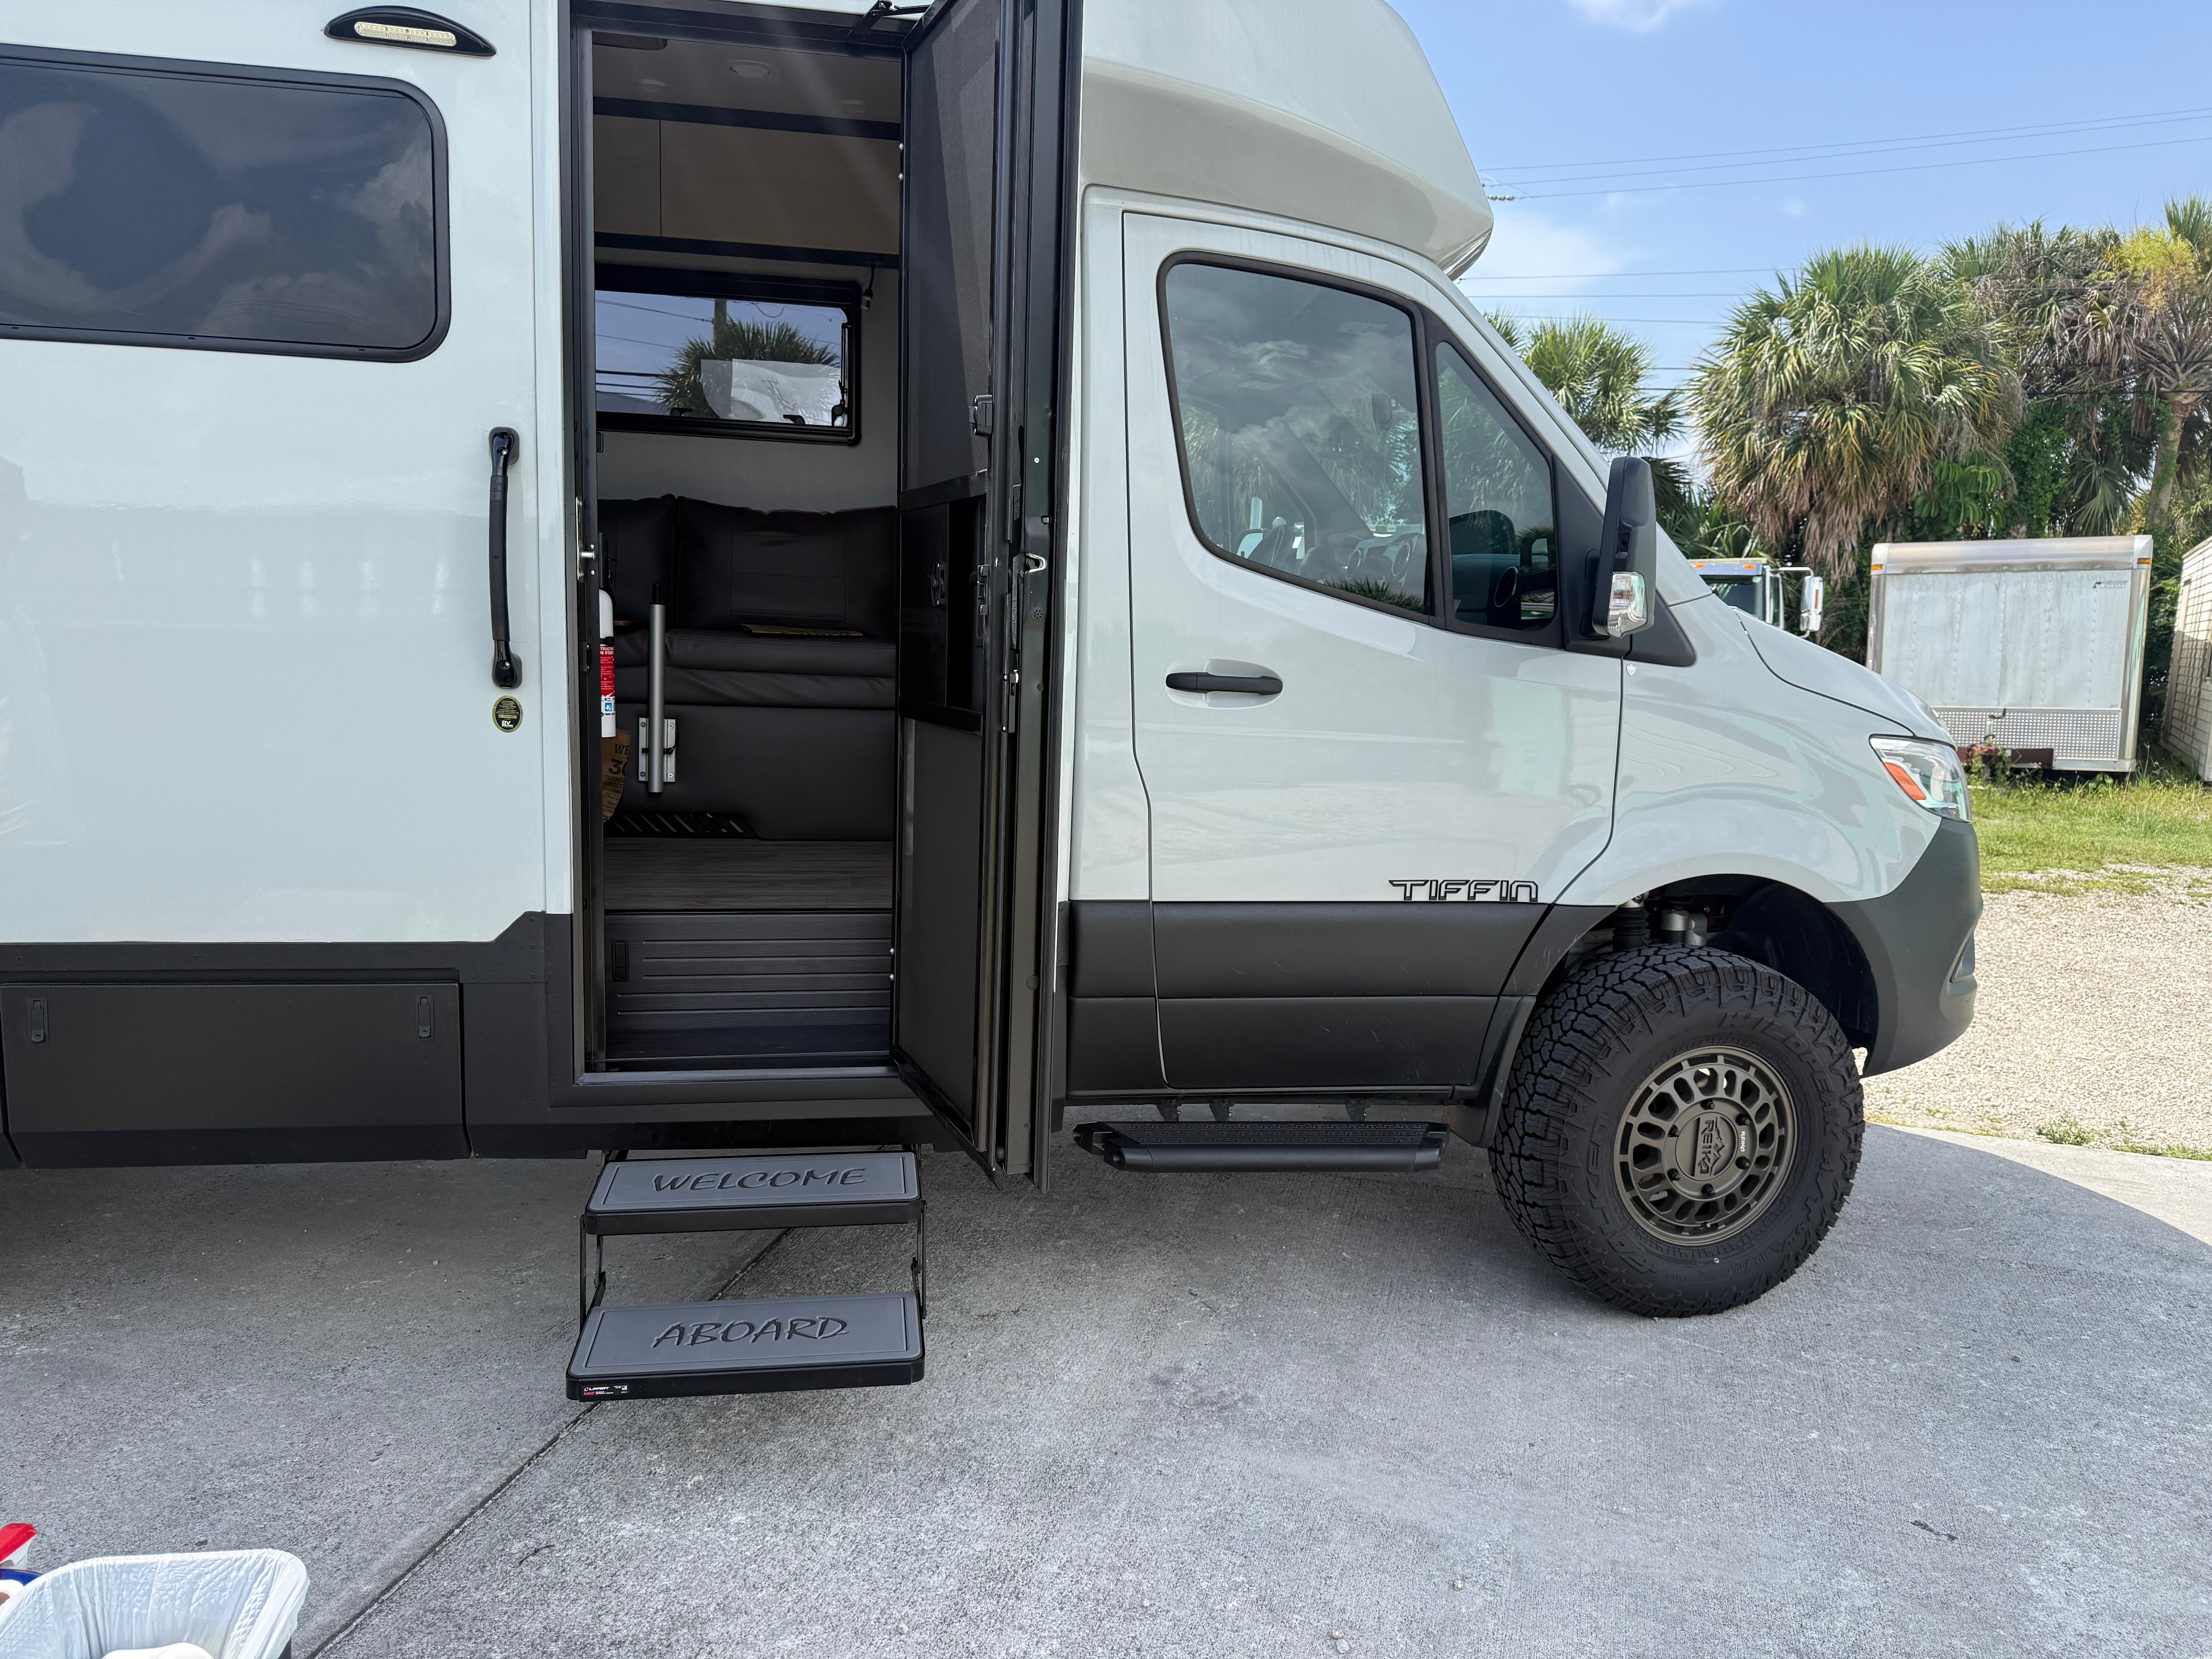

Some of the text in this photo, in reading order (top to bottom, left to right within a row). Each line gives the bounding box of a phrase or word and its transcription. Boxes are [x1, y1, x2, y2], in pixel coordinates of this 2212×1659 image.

[1388, 879, 1538, 902] TIFFIN
[1719, 1012, 1839, 1138] WILDPEAK
[652, 1167, 867, 1192] WELCOME
[1586, 1111, 1657, 1274] FALKEN
[650, 1316, 849, 1348] ABOARD
